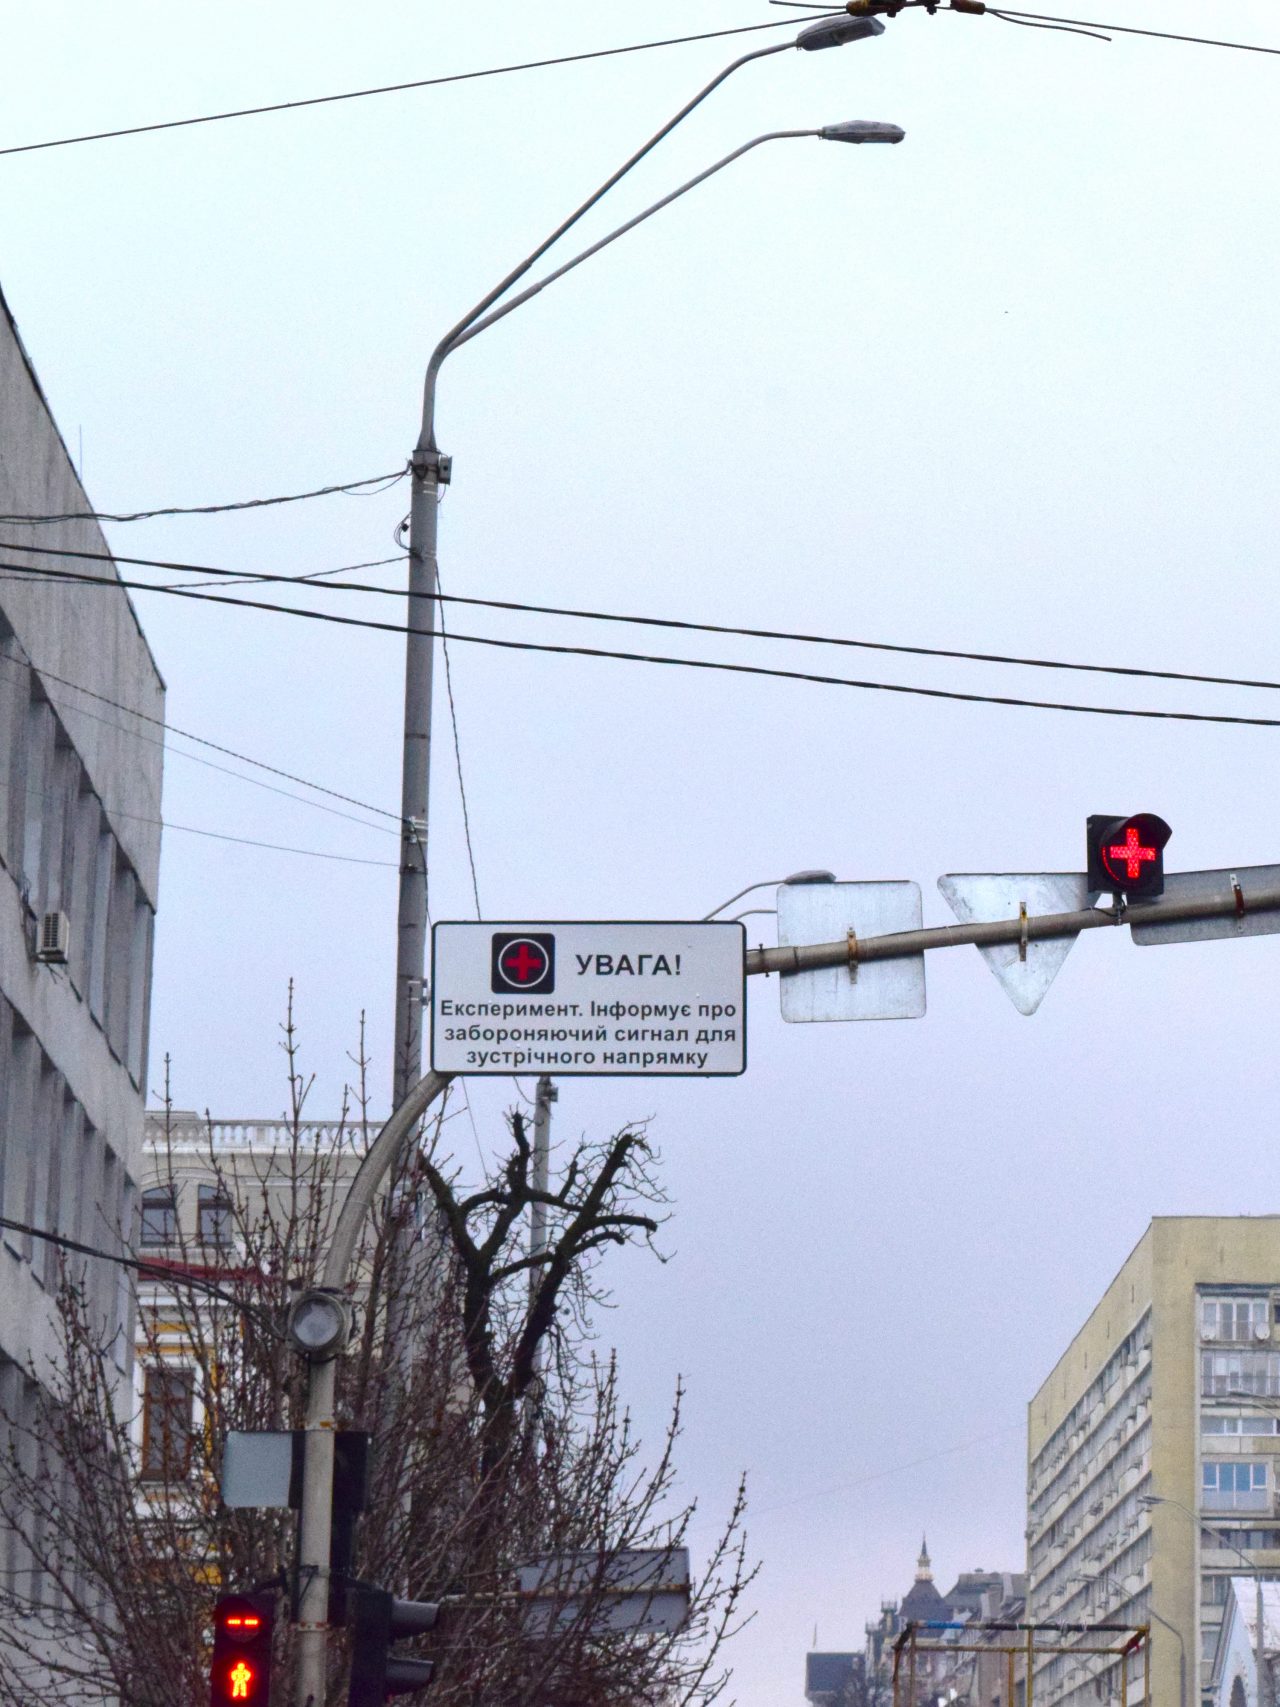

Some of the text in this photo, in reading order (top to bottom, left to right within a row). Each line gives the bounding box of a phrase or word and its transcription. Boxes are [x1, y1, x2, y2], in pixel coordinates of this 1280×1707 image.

[575, 954, 682, 976] УВАГА!
[440, 1000, 737, 1020] Експеримент. Інформує про
[444, 1025, 737, 1045] забороняючий сигнал для
[466, 1048, 709, 1069] зустрічного напрямку
